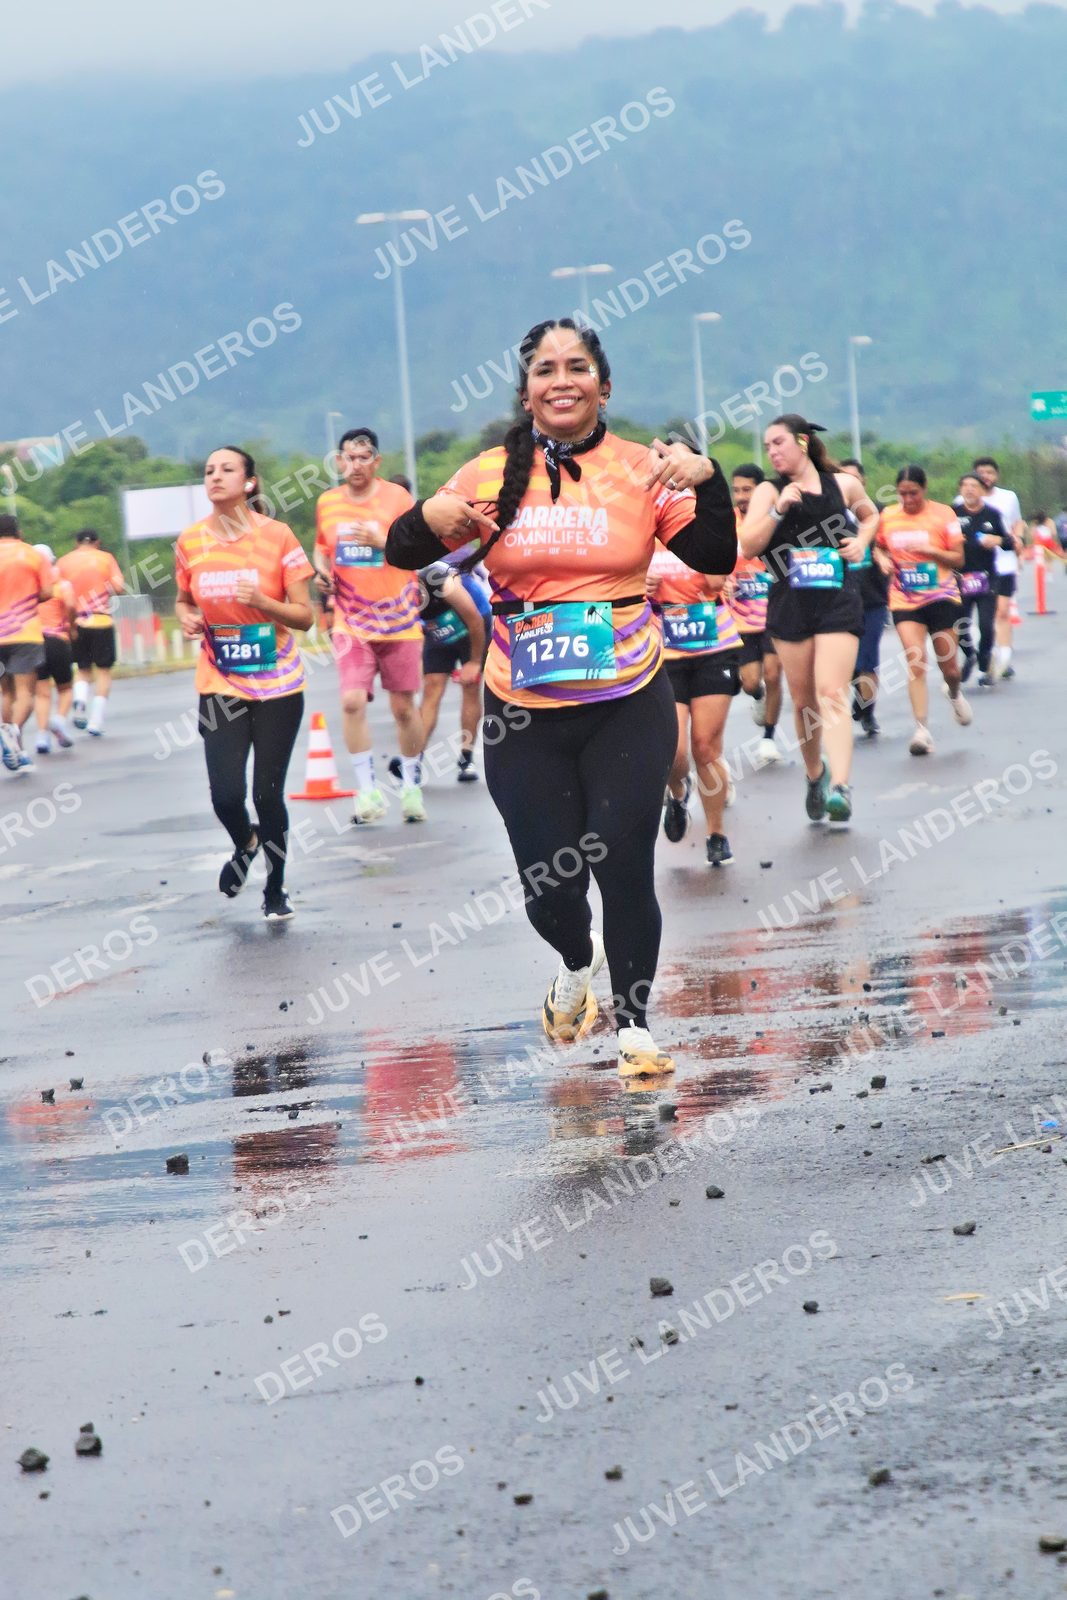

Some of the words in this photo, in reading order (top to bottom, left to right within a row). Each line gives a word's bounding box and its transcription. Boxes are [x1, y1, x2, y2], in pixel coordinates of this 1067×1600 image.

[504, 531, 585, 547] OMNILIFE
[221, 643, 261, 659] 1281
[527, 635, 590, 665] 1276
